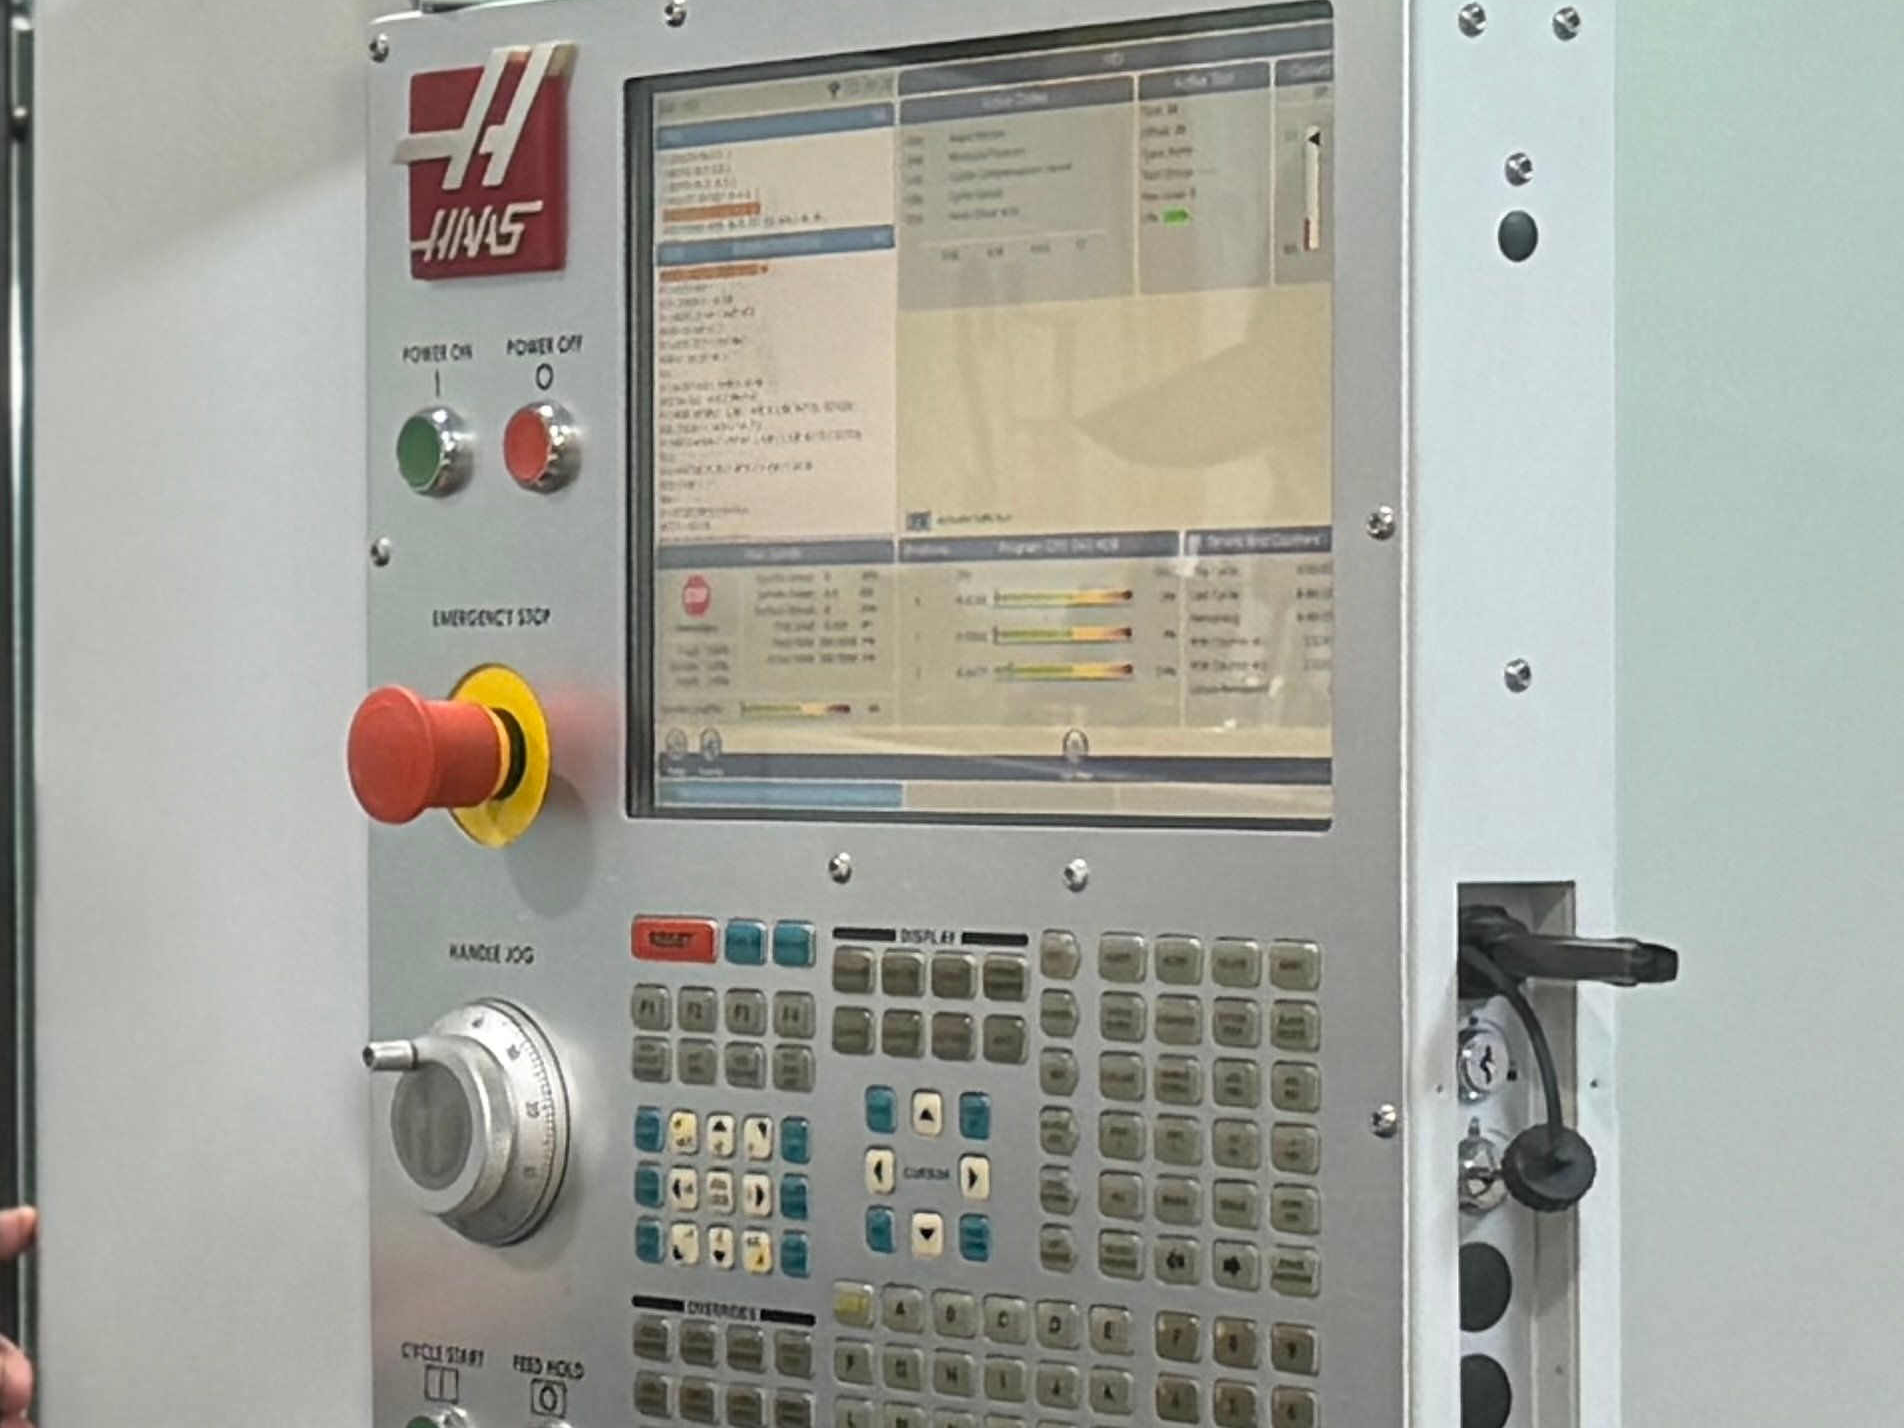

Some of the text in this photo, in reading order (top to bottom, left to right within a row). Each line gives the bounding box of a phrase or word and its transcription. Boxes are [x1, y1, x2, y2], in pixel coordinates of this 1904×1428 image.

[410, 200, 543, 261] HAAS
[403, 343, 472, 362] POWER ON
[507, 334, 583, 356] POWER OFF
[432, 609, 513, 627] EMERGENCY
[900, 928, 956, 944] DISPLAY
[449, 943, 535, 964] HANDLE JOG
[401, 1341, 442, 1361] CYCLE
[513, 1355, 585, 1380] FEED HOLD
